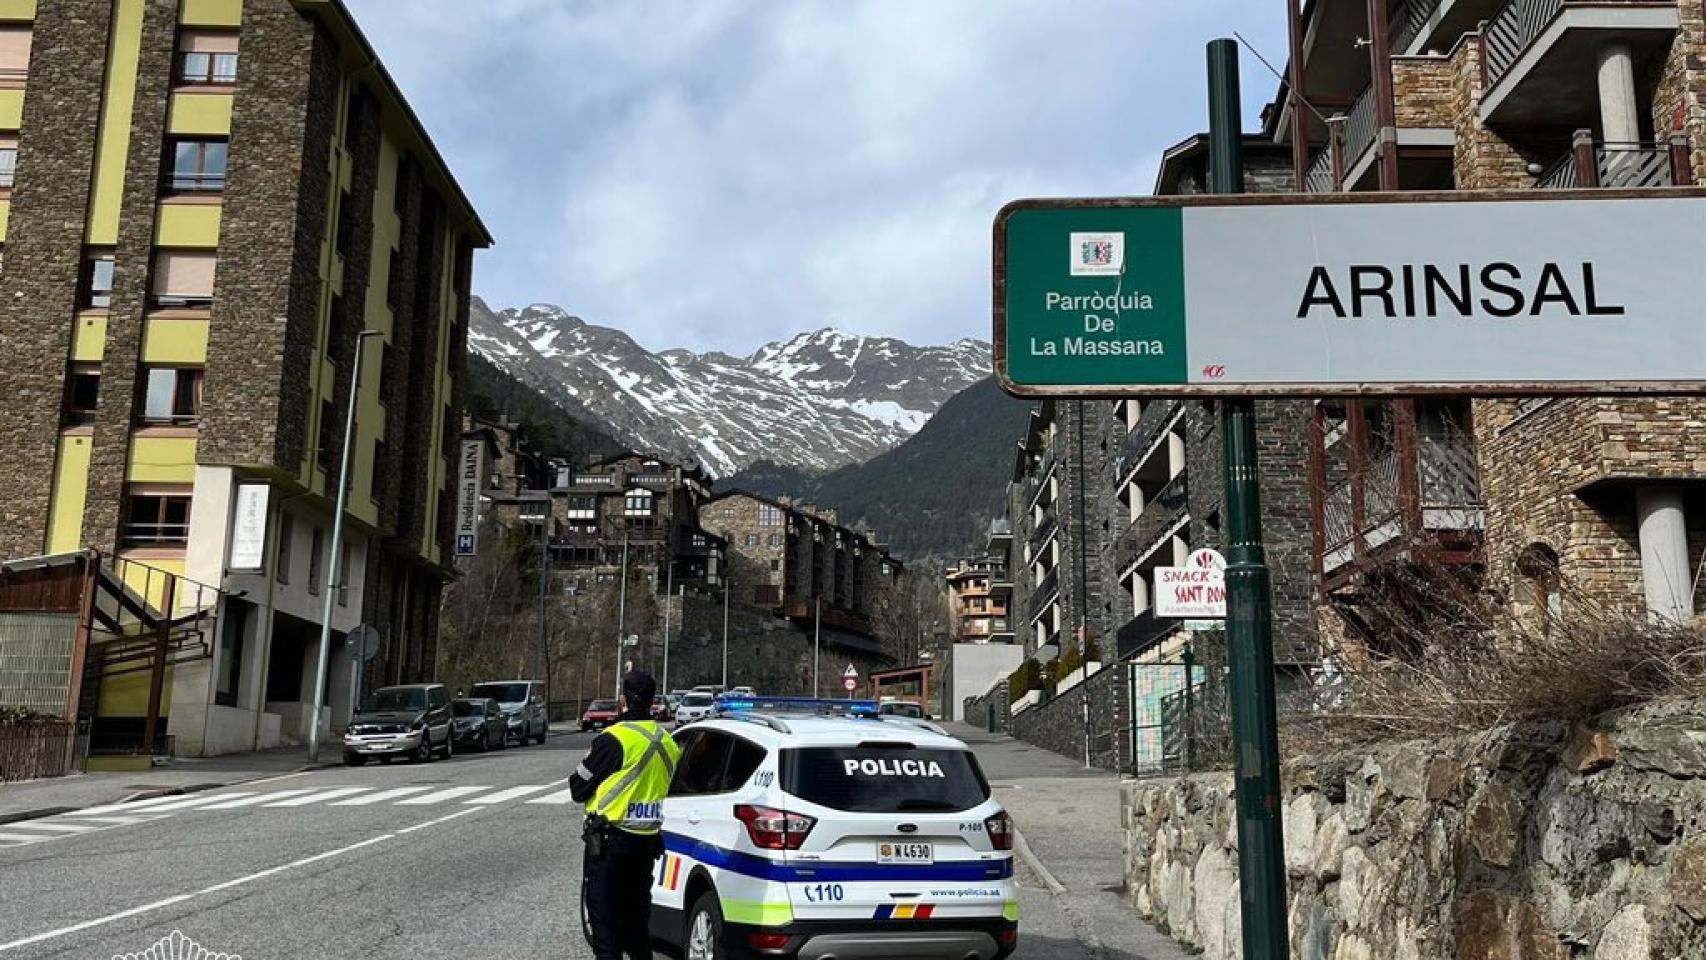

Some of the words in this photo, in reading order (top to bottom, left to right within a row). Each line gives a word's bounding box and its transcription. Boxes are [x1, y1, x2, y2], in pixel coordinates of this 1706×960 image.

[1296, 262, 1625, 318] ARINSAL
[1046, 291, 1153, 314] Parròquia
[1084, 314, 1115, 332] De
[1030, 337, 1057, 356] La
[1064, 336, 1164, 356] Massana
[464, 443, 478, 479] DAINA
[460, 536, 473, 548] H
[1163, 571, 1209, 582] SNACK
[1175, 585, 1204, 603] SANT
[843, 759, 945, 778] POLICIA
[815, 884, 843, 901] 110
